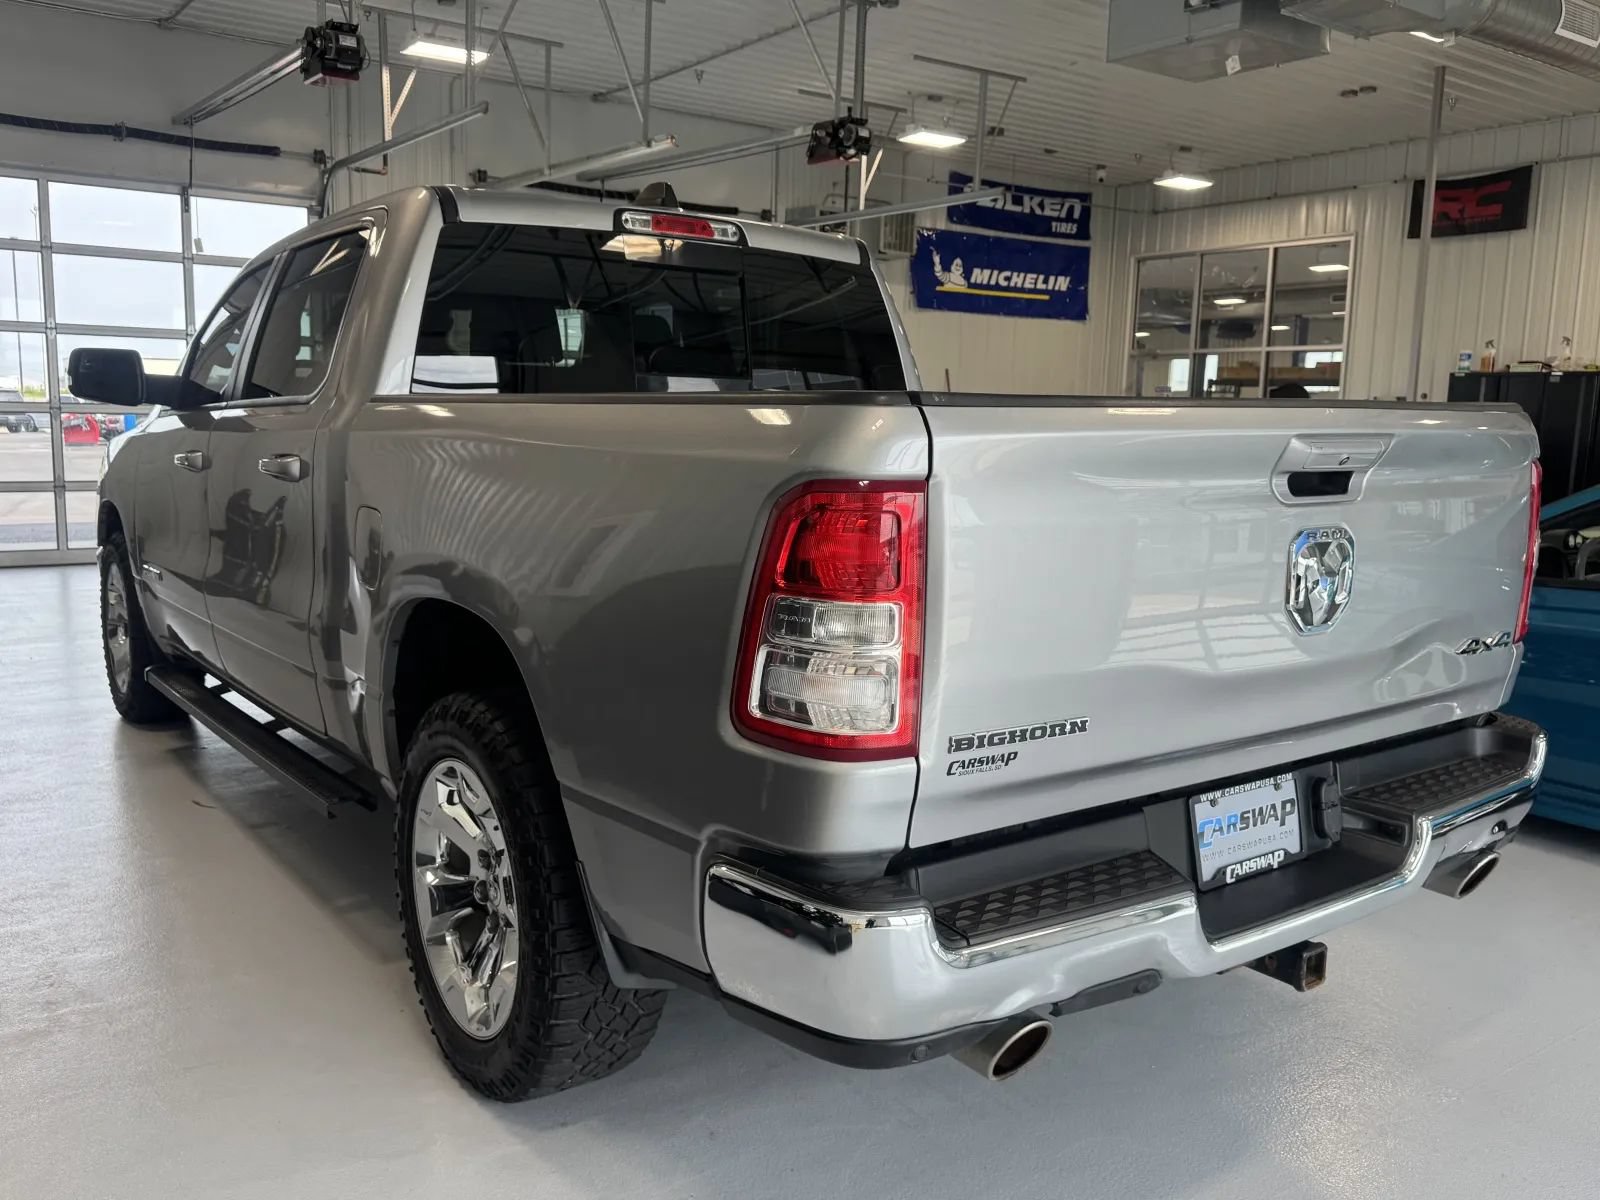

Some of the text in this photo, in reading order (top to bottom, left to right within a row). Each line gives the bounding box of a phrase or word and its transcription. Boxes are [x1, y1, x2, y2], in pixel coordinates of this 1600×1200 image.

[1051, 221, 1078, 235] TIRES
[970, 267, 1071, 291] MICHELIN
[1306, 528, 1348, 540] RAM
[948, 716, 1089, 754] BIGHORN
[946, 751, 1018, 777] CARSWAP
[958, 769, 975, 777] SIOUX
[1200, 773, 1293, 802] WWW.CARSWAPUSA.COM
[1197, 797, 1296, 849] CARSWAP
[1226, 850, 1285, 884] CARSWAP
